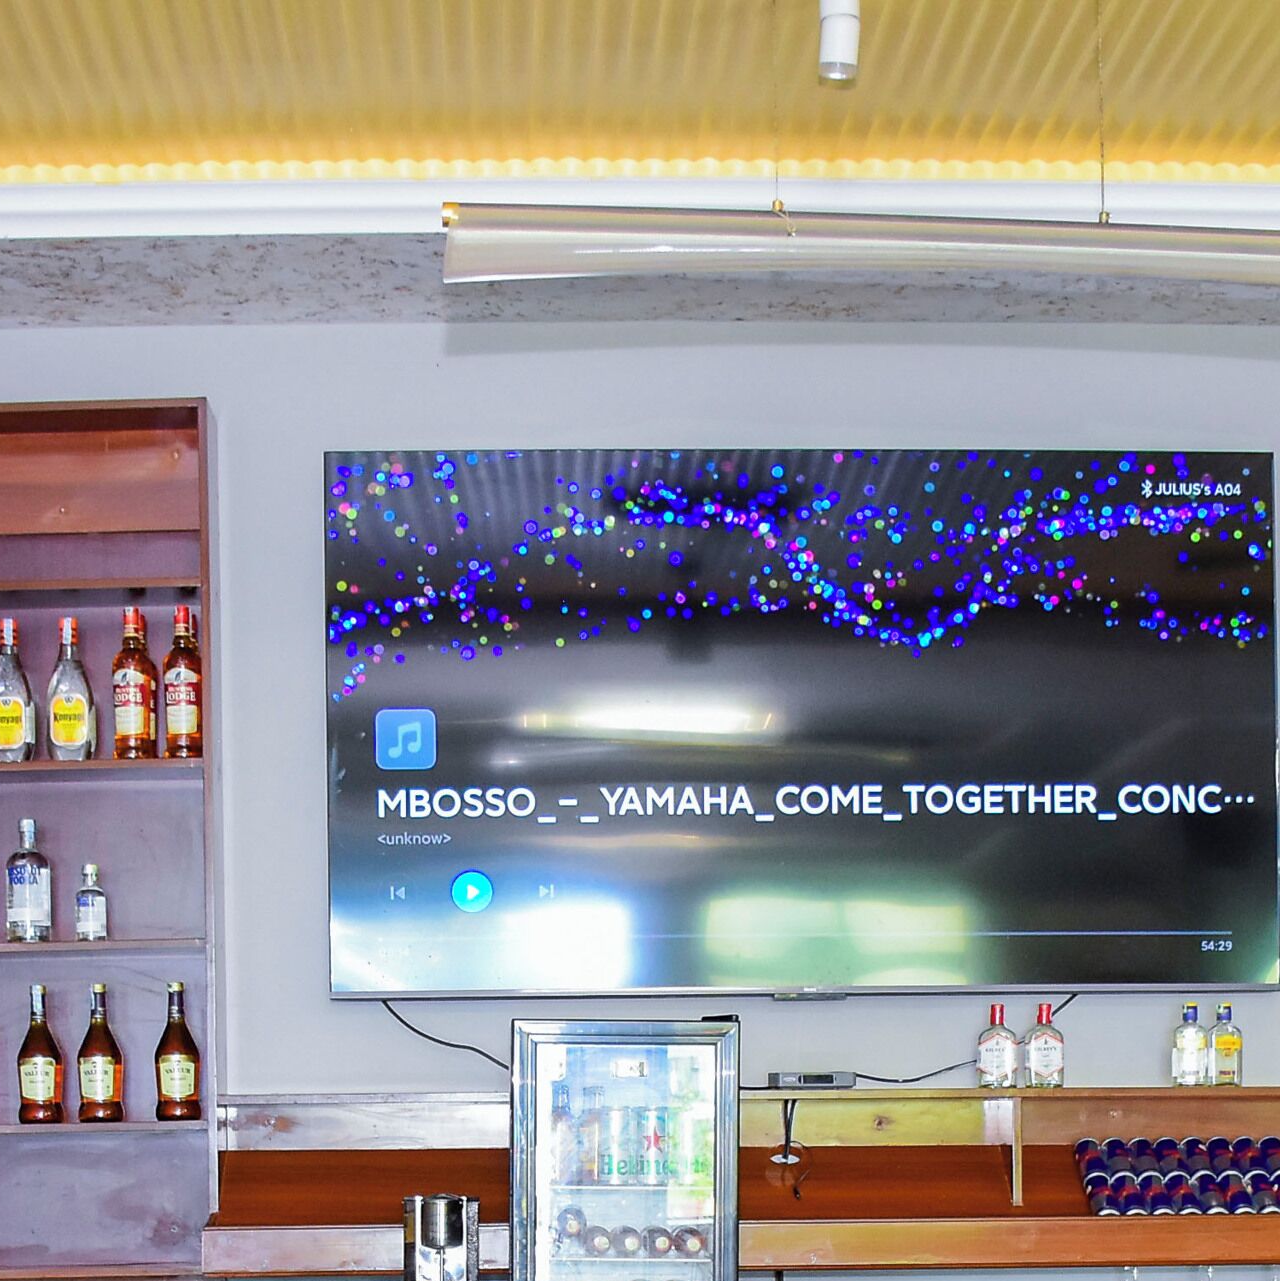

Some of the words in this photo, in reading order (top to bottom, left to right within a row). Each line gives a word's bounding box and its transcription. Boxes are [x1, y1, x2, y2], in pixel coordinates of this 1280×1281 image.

[1154, 482, 1212, 496] JULIUS's
[1214, 483, 1242, 496] A04
[166, 691, 197, 704] LODGE
[377, 831, 452, 847] <unknow>
[1201, 940, 1233, 951] 54:29
